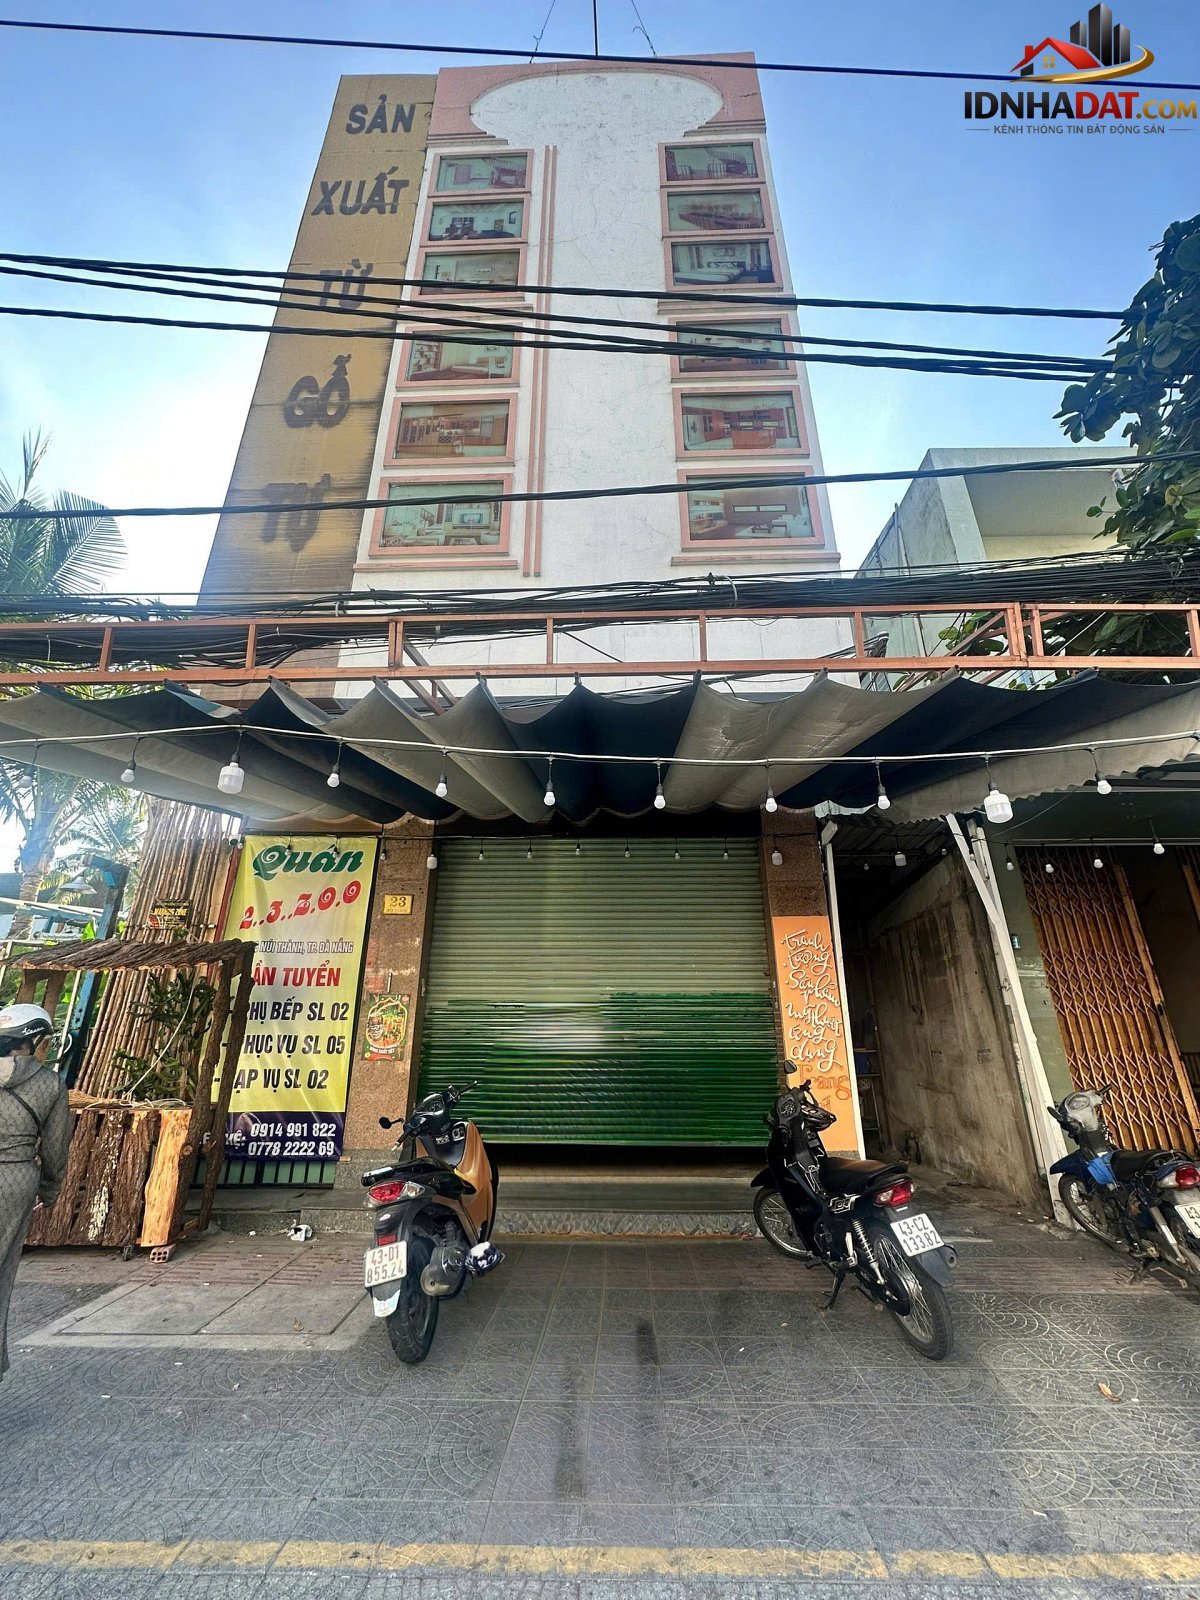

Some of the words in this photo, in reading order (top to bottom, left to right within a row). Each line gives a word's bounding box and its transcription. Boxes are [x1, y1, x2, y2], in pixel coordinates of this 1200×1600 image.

[346, 94, 416, 134] SẢN
[311, 166, 410, 216] XUẤT
[252, 843, 364, 881] Quán
[389, 895, 407, 908] 23
[307, 941, 318, 953] TP.
[319, 939, 330, 953] ĐÀ
[253, 960, 277, 986] ẦN
[283, 959, 341, 987] TUYỂN
[249, 1001, 267, 1024] HỤ
[270, 996, 303, 1020] BẾP
[307, 1002, 325, 1021] SL
[330, 1002, 350, 1021] 02
[243, 1034, 273, 1058] HỤC
[277, 1034, 299, 1058] VỤ
[302, 1035, 321, 1054] SL
[326, 1035, 346, 1054] 05
[234, 1069, 259, 1094] ẠP
[263, 1068, 281, 1093] VỤ
[284, 1069, 301, 1089] SL
[307, 1069, 329, 1089] 02
[250, 1122, 283, 1137] 0914
[286, 1122, 308, 1137] 991
[312, 1122, 337, 1137] 822
[248, 1141, 281, 1156] 0778
[283, 1141, 315, 1156] 2222
[318, 1141, 335, 1156] 69
[902, 1230, 941, 1253] 133.82
